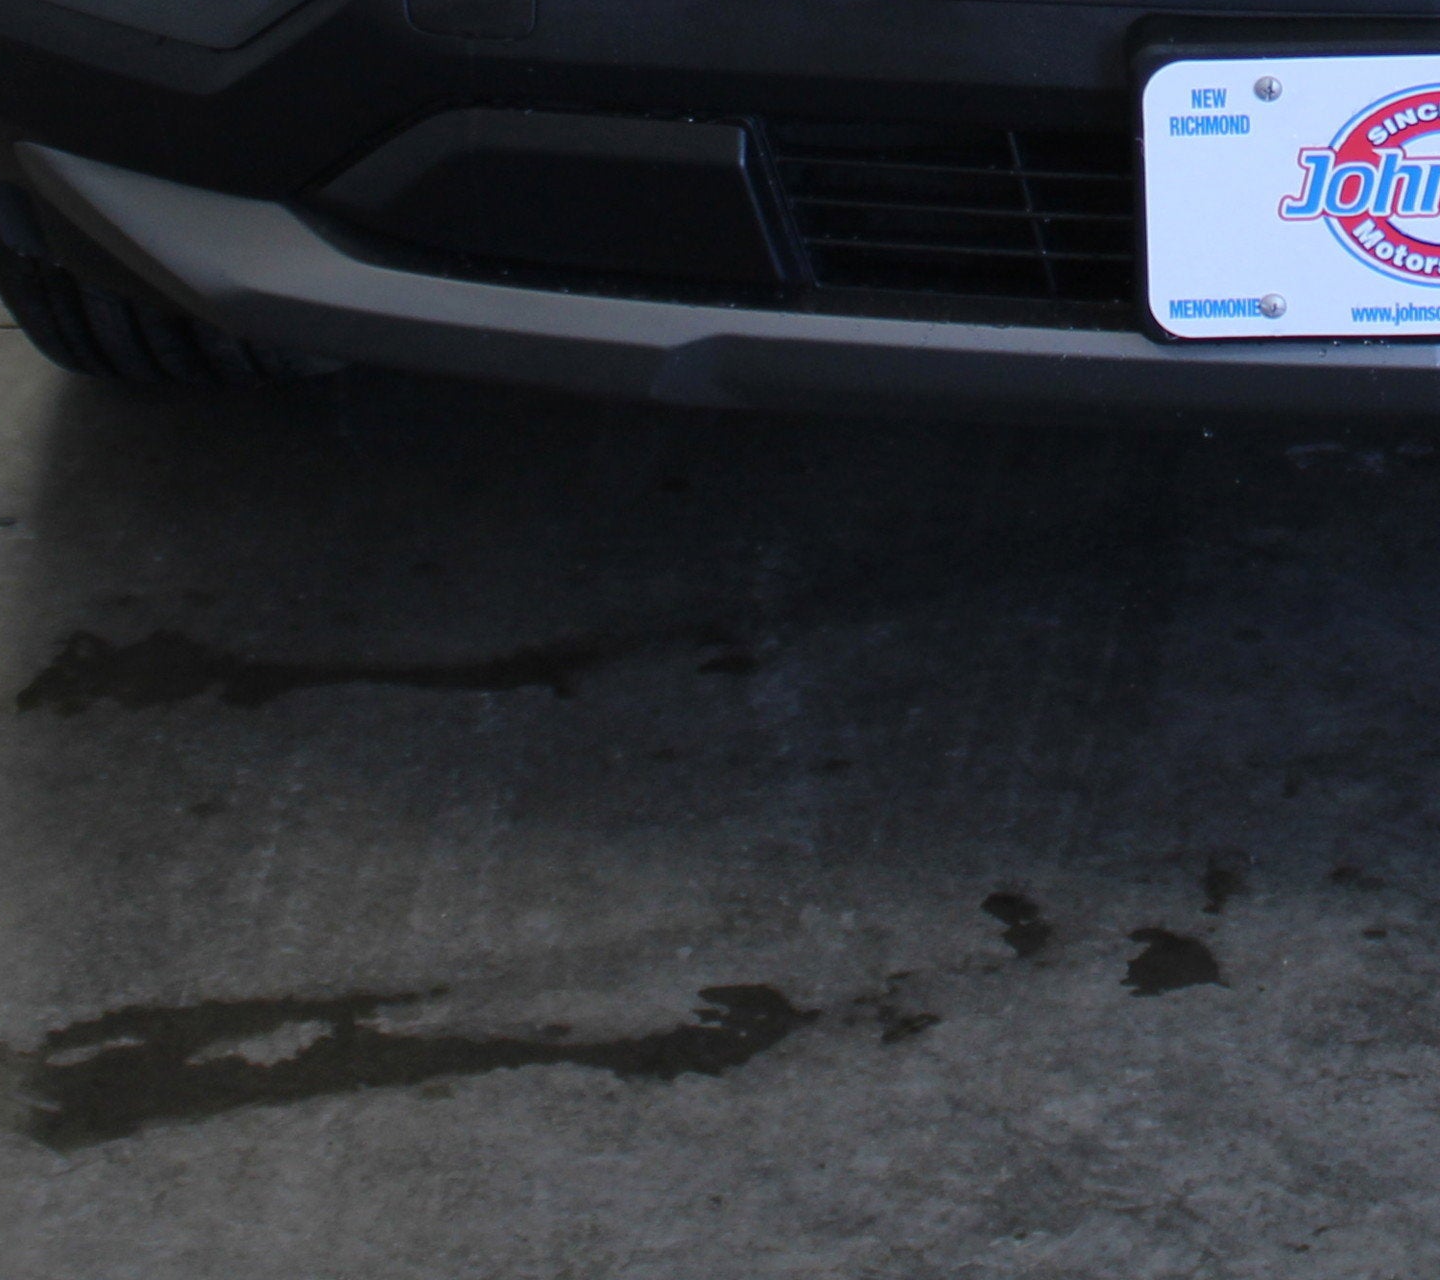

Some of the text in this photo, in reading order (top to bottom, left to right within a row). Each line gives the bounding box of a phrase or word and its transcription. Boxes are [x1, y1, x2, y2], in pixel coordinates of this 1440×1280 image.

[1191, 88, 1227, 109] NEW
[1169, 114, 1251, 136] RICHMOND
[1169, 298, 1261, 319] MENOMONIE
